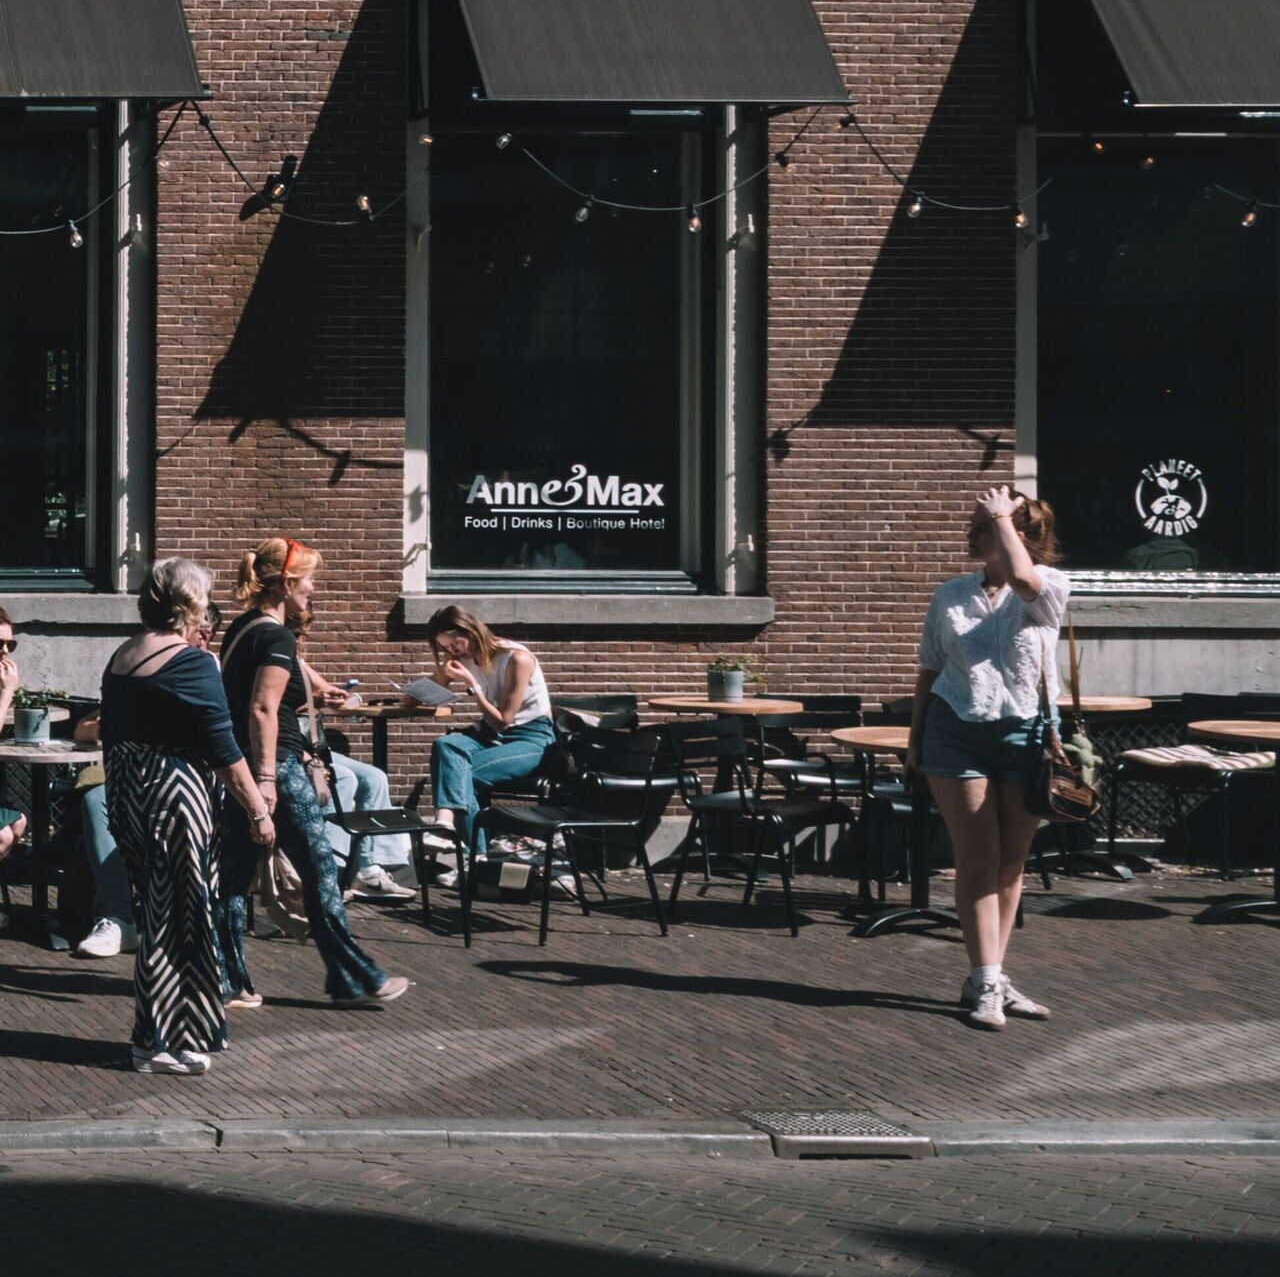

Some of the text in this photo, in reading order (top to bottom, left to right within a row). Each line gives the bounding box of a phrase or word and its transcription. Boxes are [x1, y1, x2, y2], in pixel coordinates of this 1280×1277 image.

[1141, 459, 1202, 482] PLANEET
[464, 516, 665, 531] Food Drinks Boutique Hotel
[1143, 515, 1198, 536] AARDIG
